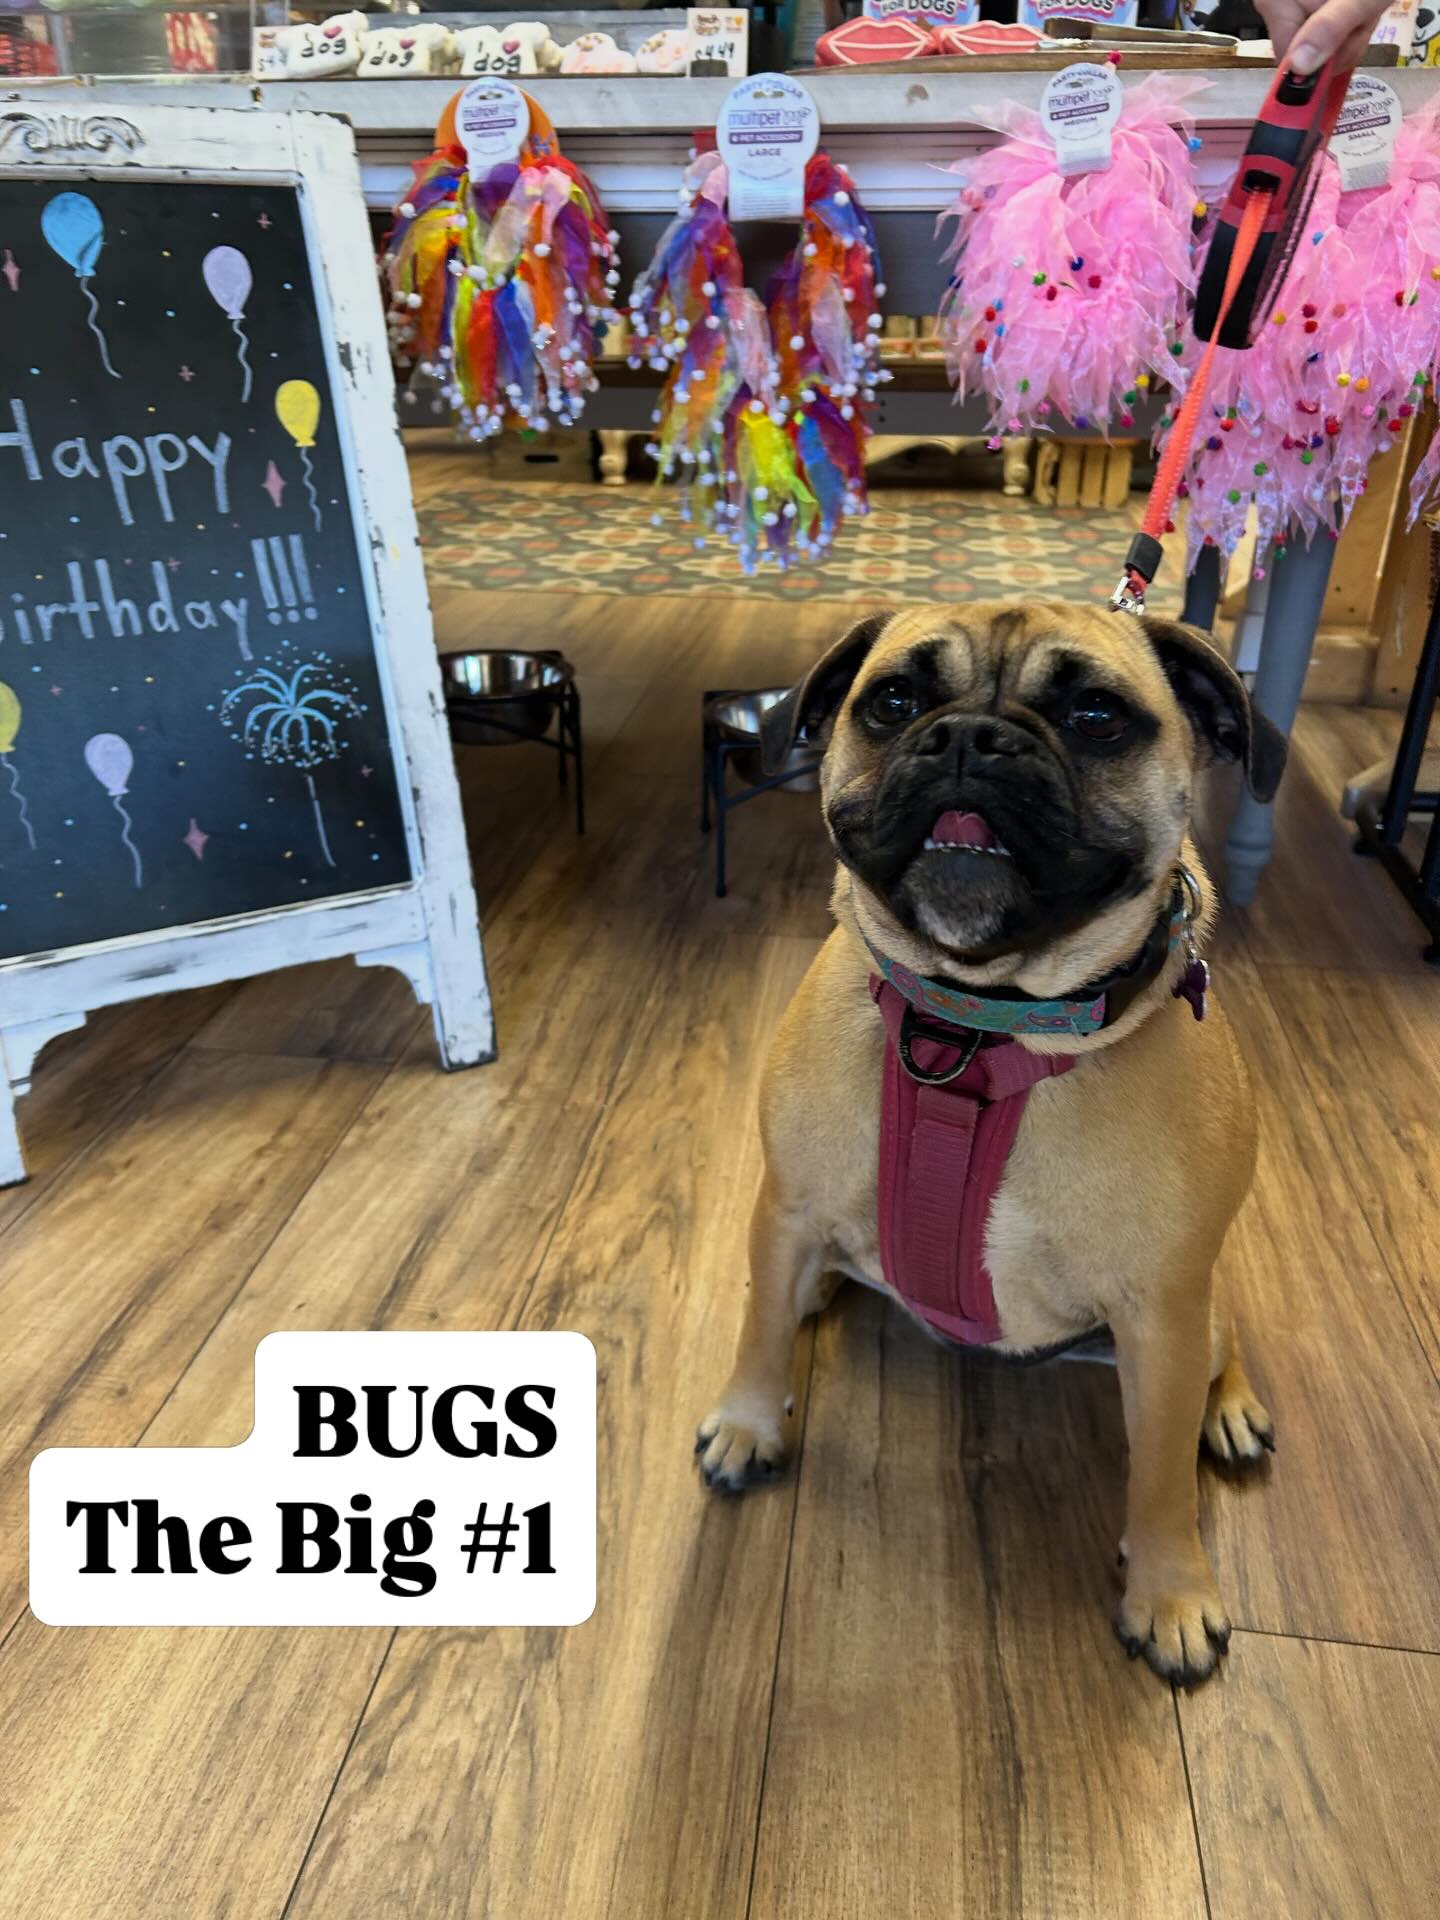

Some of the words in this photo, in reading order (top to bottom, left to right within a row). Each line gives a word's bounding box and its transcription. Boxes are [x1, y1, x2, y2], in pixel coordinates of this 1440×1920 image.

[908, 0, 956, 15] DOGS
[301, 38, 346, 58] dog
[370, 50, 414, 67] dog
[473, 53, 521, 73] dog
[1355, 81, 1387, 92] COLLAR
[728, 111, 781, 127] multipet
[1348, 130, 1376, 140] SMALL
[747, 147, 781, 157] LARGE
[0, 398, 232, 526] Happy
[0, 533, 318, 662] irthday!!!
